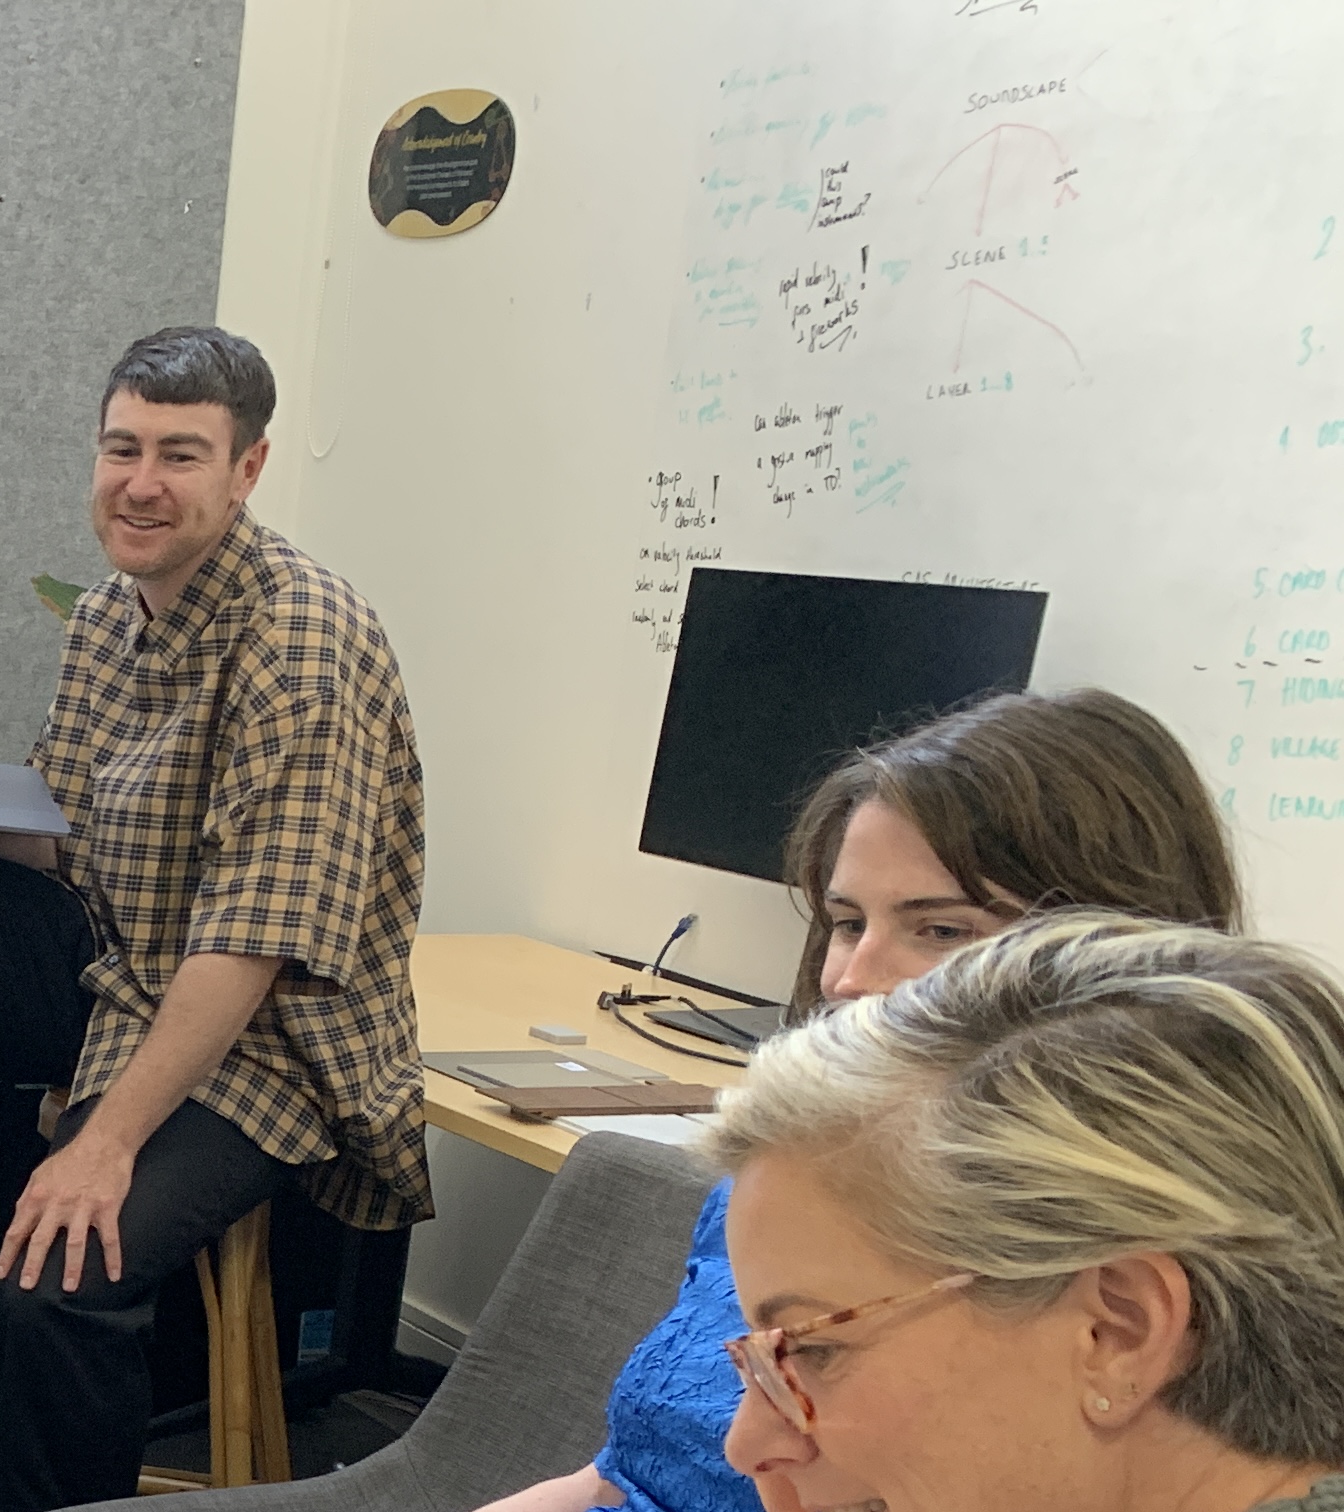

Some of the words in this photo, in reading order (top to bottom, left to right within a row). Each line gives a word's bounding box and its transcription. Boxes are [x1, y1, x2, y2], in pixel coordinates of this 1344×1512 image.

[963, 78, 1067, 114] SOUNDSCAPE
[945, 246, 1006, 270] SCENE
[925, 382, 972, 400] LAYER
[674, 508, 707, 529] chords
[1278, 628, 1330, 654] CARD
[1237, 679, 1256, 709] 7
[1227, 734, 1244, 766] 8
